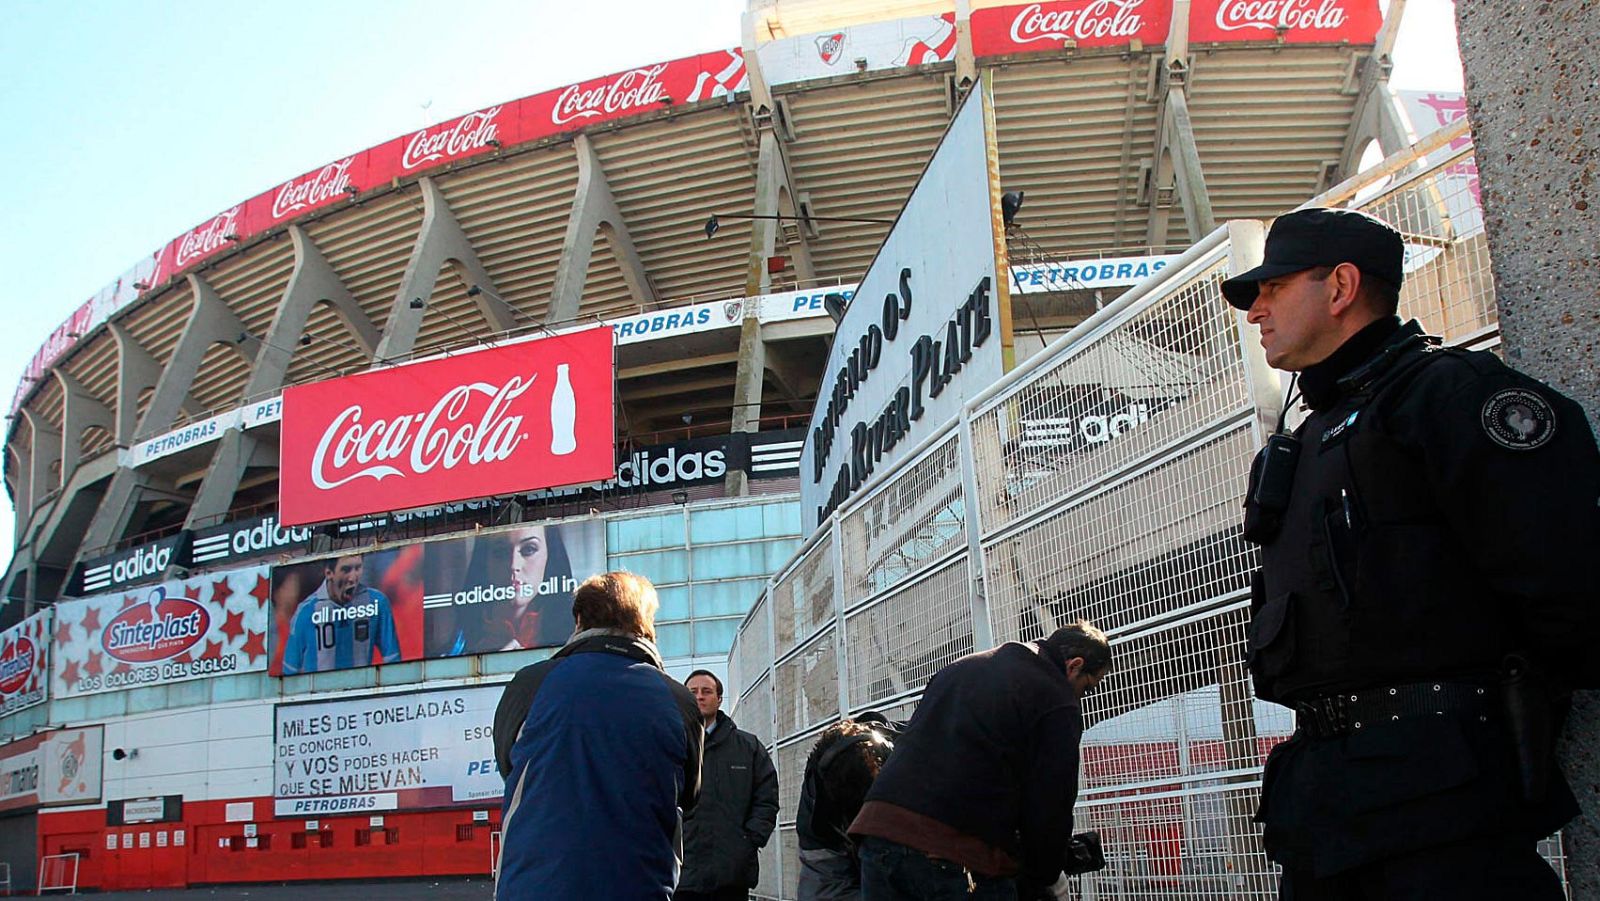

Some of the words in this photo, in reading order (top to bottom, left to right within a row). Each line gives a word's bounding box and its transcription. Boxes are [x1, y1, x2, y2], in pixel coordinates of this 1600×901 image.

[1010, 0, 1146, 43] Coca-Cola
[1215, 0, 1346, 31] Coca-Cola
[551, 61, 668, 125] Coca-Cola
[402, 105, 503, 169] Coca-Cola
[272, 156, 355, 219] Coca-Cola
[1013, 260, 1167, 287] PETROBRAS
[909, 276, 991, 421] PLATE
[146, 421, 217, 457] PETROBRAS
[311, 372, 538, 490] Coca-Cola
[591, 446, 727, 491] didas
[113, 544, 174, 583] adida
[454, 584, 516, 606] adidas
[519, 581, 534, 597] is
[537, 576, 559, 595] all
[562, 575, 579, 593] in
[311, 606, 329, 624] all
[332, 599, 379, 621] messi
[109, 611, 201, 649] Sinteplast
[314, 622, 336, 651] 10
[78, 676, 103, 692] LOS
[105, 665, 160, 689] COLORES
[163, 662, 187, 680] DEL
[191, 653, 237, 675] SIGLO!
[337, 714, 357, 732] DE
[362, 698, 465, 727] TONELADAS
[280, 744, 296, 758] DE
[299, 733, 372, 755] CONCRETO,
[285, 761, 296, 778] Y
[303, 755, 340, 776] VOS
[344, 753, 388, 772] PODES
[392, 747, 439, 765] HACER
[280, 782, 305, 796] QUE
[310, 779, 333, 796] SE
[340, 765, 427, 795] MUEVAN.
[295, 796, 377, 812] PETROBRAS
